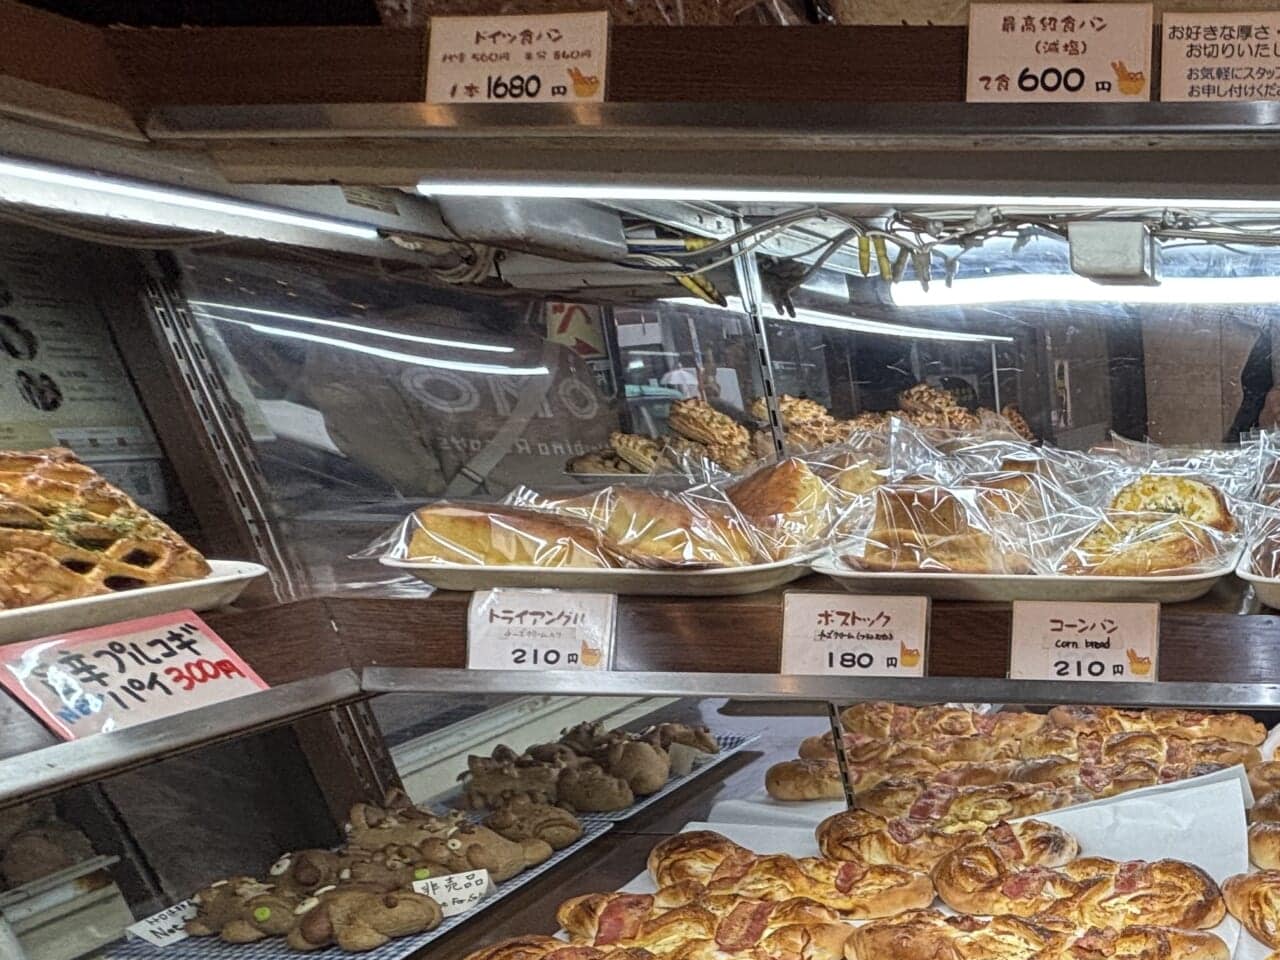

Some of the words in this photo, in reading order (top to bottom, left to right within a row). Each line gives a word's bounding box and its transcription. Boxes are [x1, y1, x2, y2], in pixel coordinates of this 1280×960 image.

[817, 609, 892, 627] ボストック
[421, 873, 484, 895] 非売品
